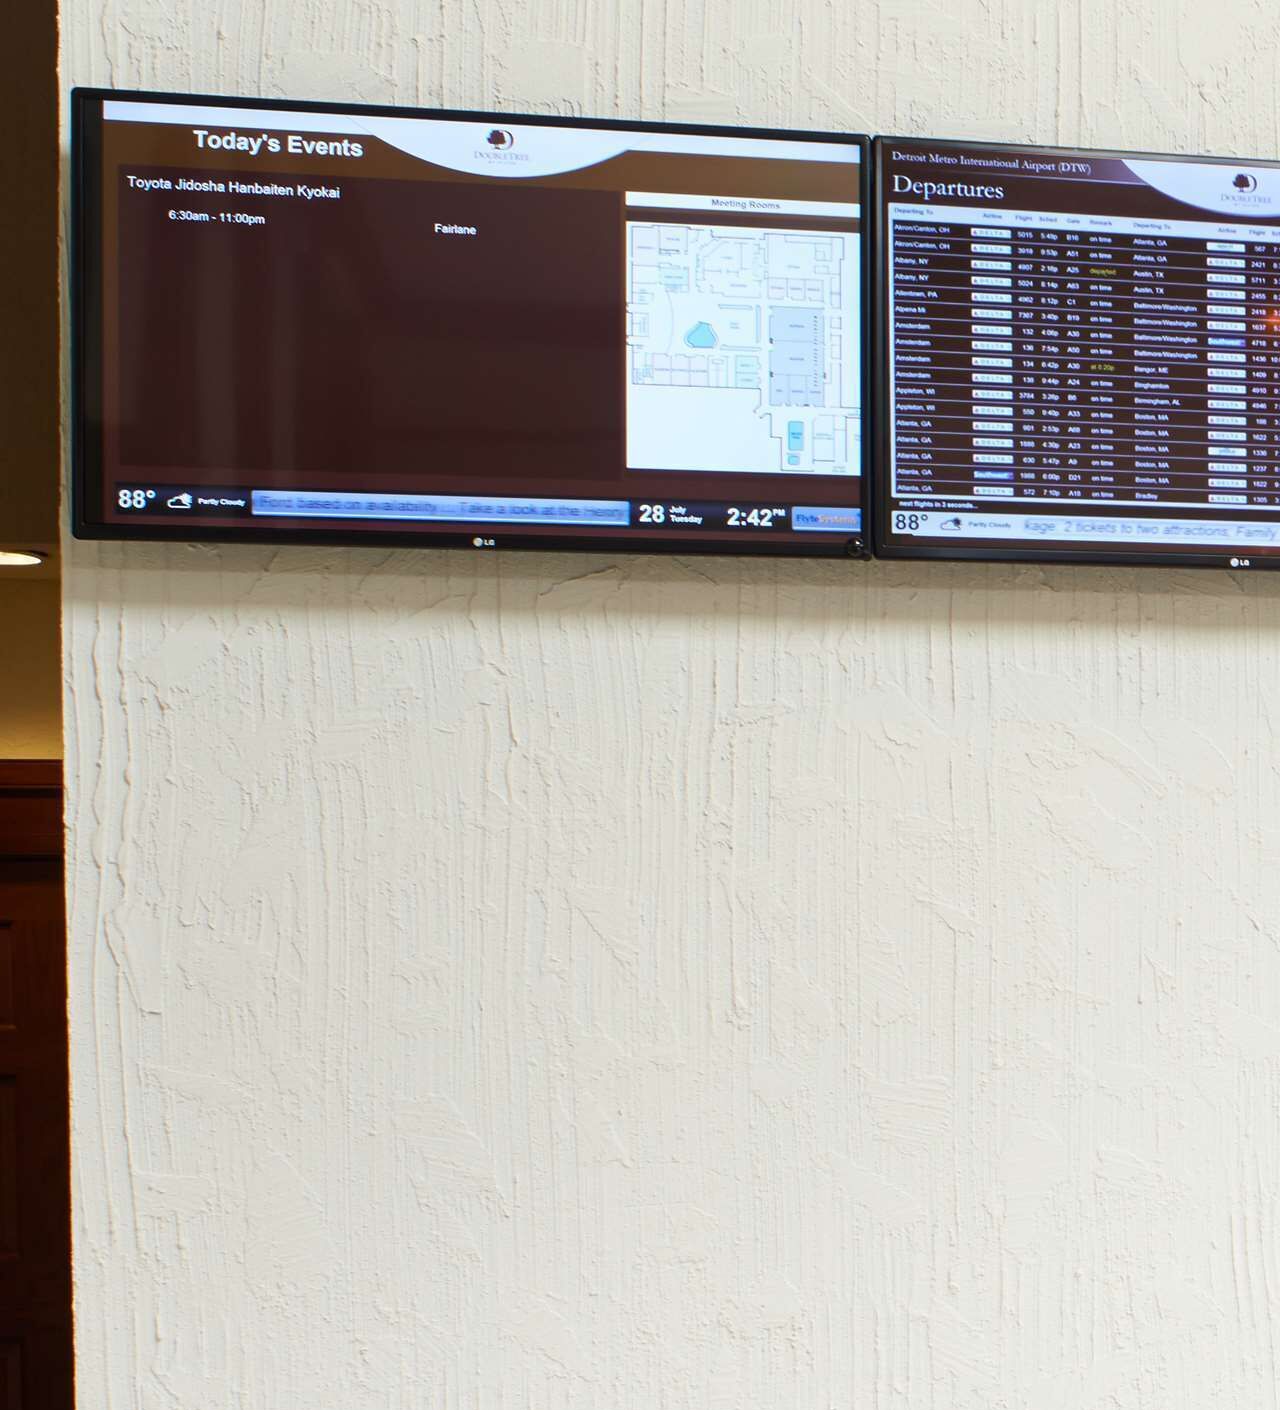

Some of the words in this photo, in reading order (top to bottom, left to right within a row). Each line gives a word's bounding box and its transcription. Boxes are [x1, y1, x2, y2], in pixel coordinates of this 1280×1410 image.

[193, 129, 281, 156] Today's
[287, 134, 364, 158] Events
[892, 151, 927, 164] Detroit
[929, 153, 958, 165] Metro
[960, 156, 1019, 169] International
[1022, 160, 1056, 173] Airport
[1058, 161, 1092, 175] (DTW)
[127, 175, 172, 190] Toyota
[175, 178, 226, 194] Jidosha
[228, 180, 294, 197] Hanbaiten
[297, 184, 341, 200] Kyokai
[892, 174, 1004, 200] Departures
[711, 198, 747, 210] Meeting
[749, 201, 781, 210] Rooms
[894, 207, 925, 216] Departing
[168, 210, 209, 222] 6:30am
[219, 212, 266, 226] 11:00pm
[434, 223, 478, 236] Fairlane
[220, 498, 246, 508] Cloudy
[298, 496, 340, 510] based
[343, 500, 361, 511] on
[668, 506, 688, 515] July
[639, 504, 666, 523] 28
[670, 514, 703, 526] Tuesday
[726, 508, 773, 527] 2:42
[1064, 521, 1072, 532] 2
[1075, 520, 1118, 534] tickets
[1120, 524, 1133, 535] to
[1136, 524, 1160, 536] two
[1236, 526, 1276, 543] Family
